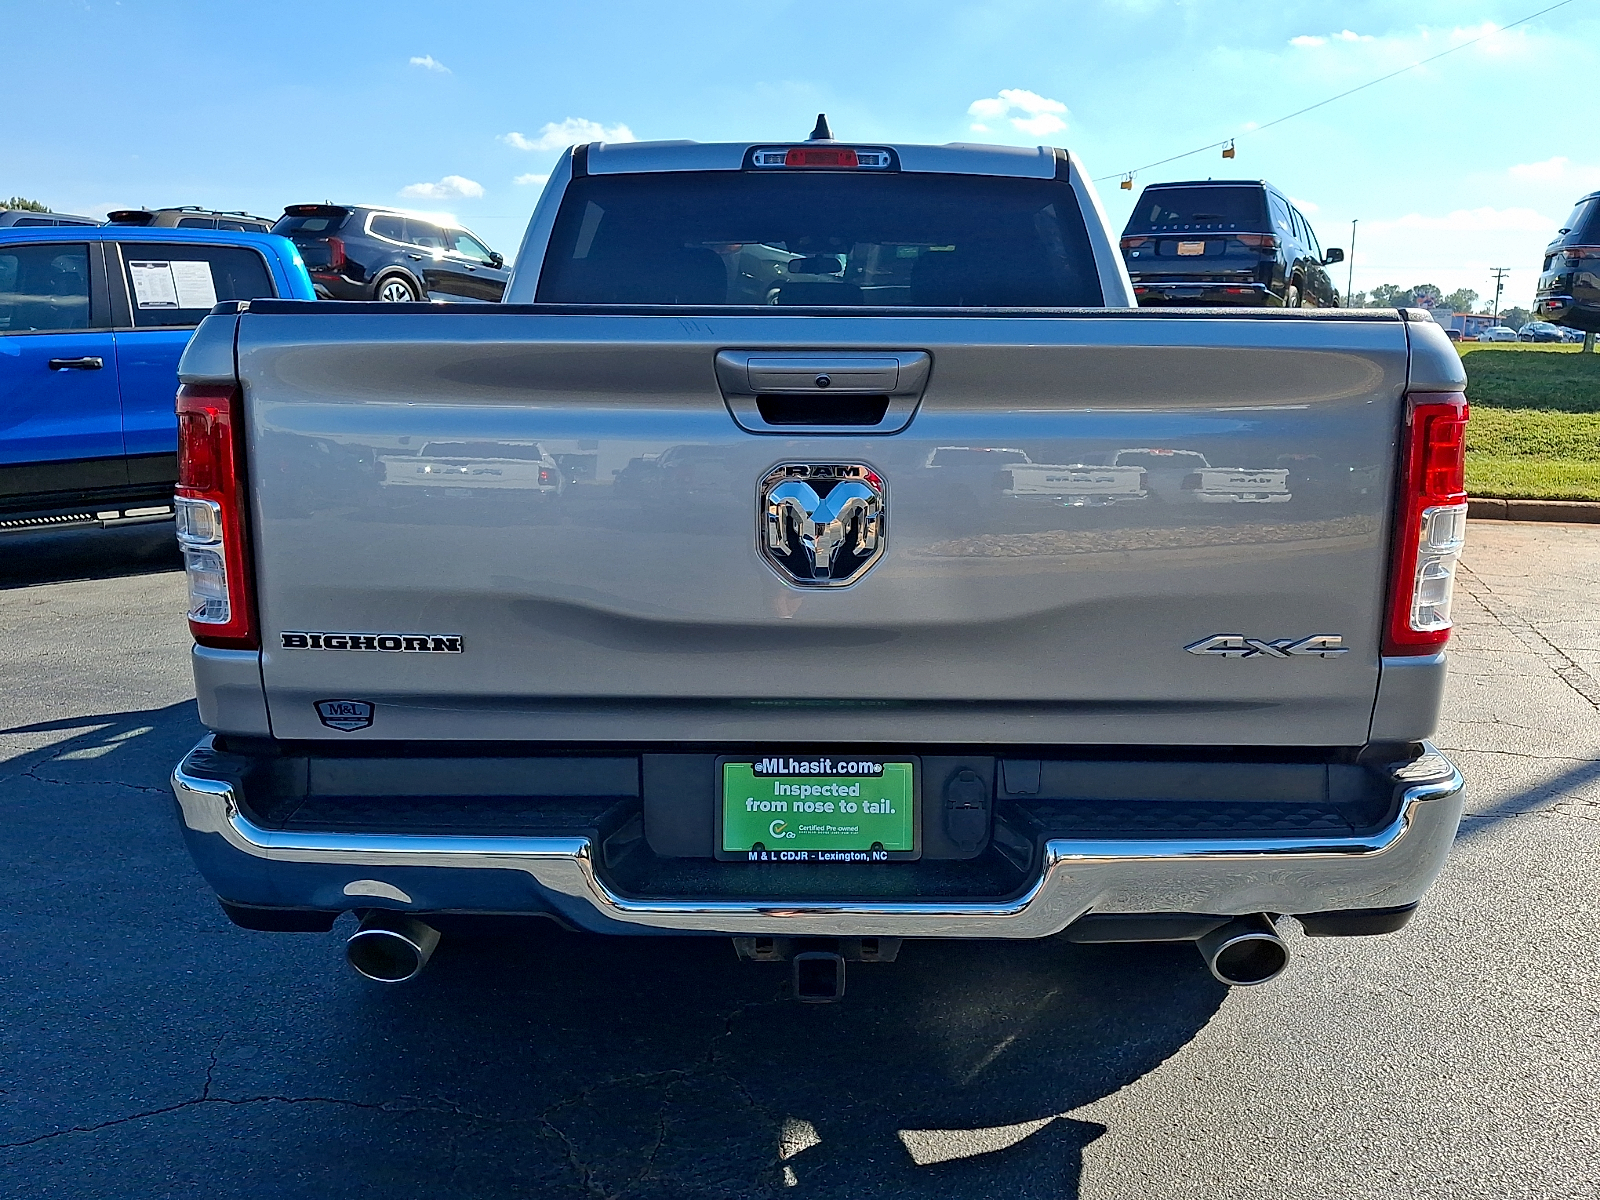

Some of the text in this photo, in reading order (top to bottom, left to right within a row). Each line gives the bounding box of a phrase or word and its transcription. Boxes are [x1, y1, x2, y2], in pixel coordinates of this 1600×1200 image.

[1151, 223, 1236, 231] WAGONEER
[785, 465, 860, 478] RAM
[280, 631, 464, 654] BIGHORN
[1183, 633, 1350, 659] 4x4
[328, 703, 363, 716] M&L
[762, 758, 873, 774] MLhasit.com
[774, 781, 860, 799] Inspected
[746, 798, 896, 814] from nose to tail.
[798, 824, 825, 833] Certified
[748, 851, 758, 860] M
[761, 852, 768, 860] &
[771, 852, 778, 860] L
[780, 851, 808, 861] CDJR
[818, 851, 870, 862] Lexington,
[872, 852, 888, 861] NC
